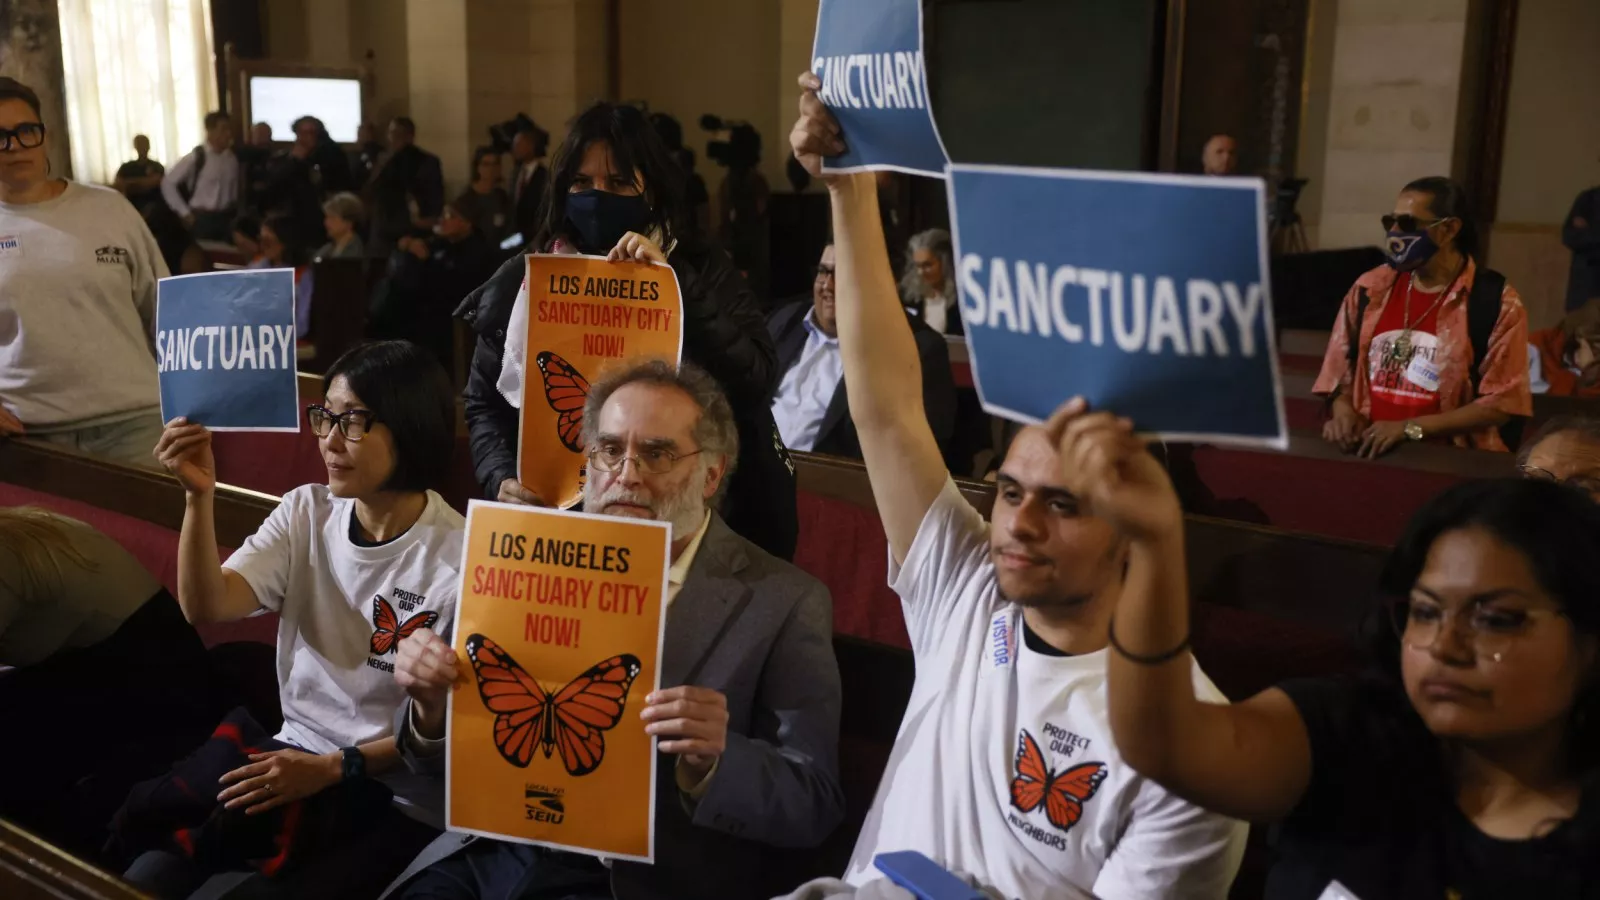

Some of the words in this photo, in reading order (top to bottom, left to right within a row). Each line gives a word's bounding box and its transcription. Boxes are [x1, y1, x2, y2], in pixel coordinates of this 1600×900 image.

[550, 274, 580, 296] LOS
[584, 277, 659, 301] ANGELES
[538, 300, 633, 329] SANCTUARY
[637, 308, 673, 332] CITY
[960, 253, 1262, 358] SANCTUARY
[156, 324, 294, 374] SANCTUARY
[583, 333, 625, 358] NOW!
[489, 531, 527, 561] LOS
[530, 537, 631, 574] ANGELES
[392, 588, 426, 605] PROTECT
[472, 564, 594, 609] SANCTUARY
[597, 581, 649, 616] CITY
[398, 600, 415, 612] OUR
[524, 612, 581, 648] NOW!
[993, 615, 1009, 666] VISITOR
[1042, 722, 1091, 750] PROTECT
[1049, 740, 1074, 757] OUR
[525, 808, 565, 825] SEIU
